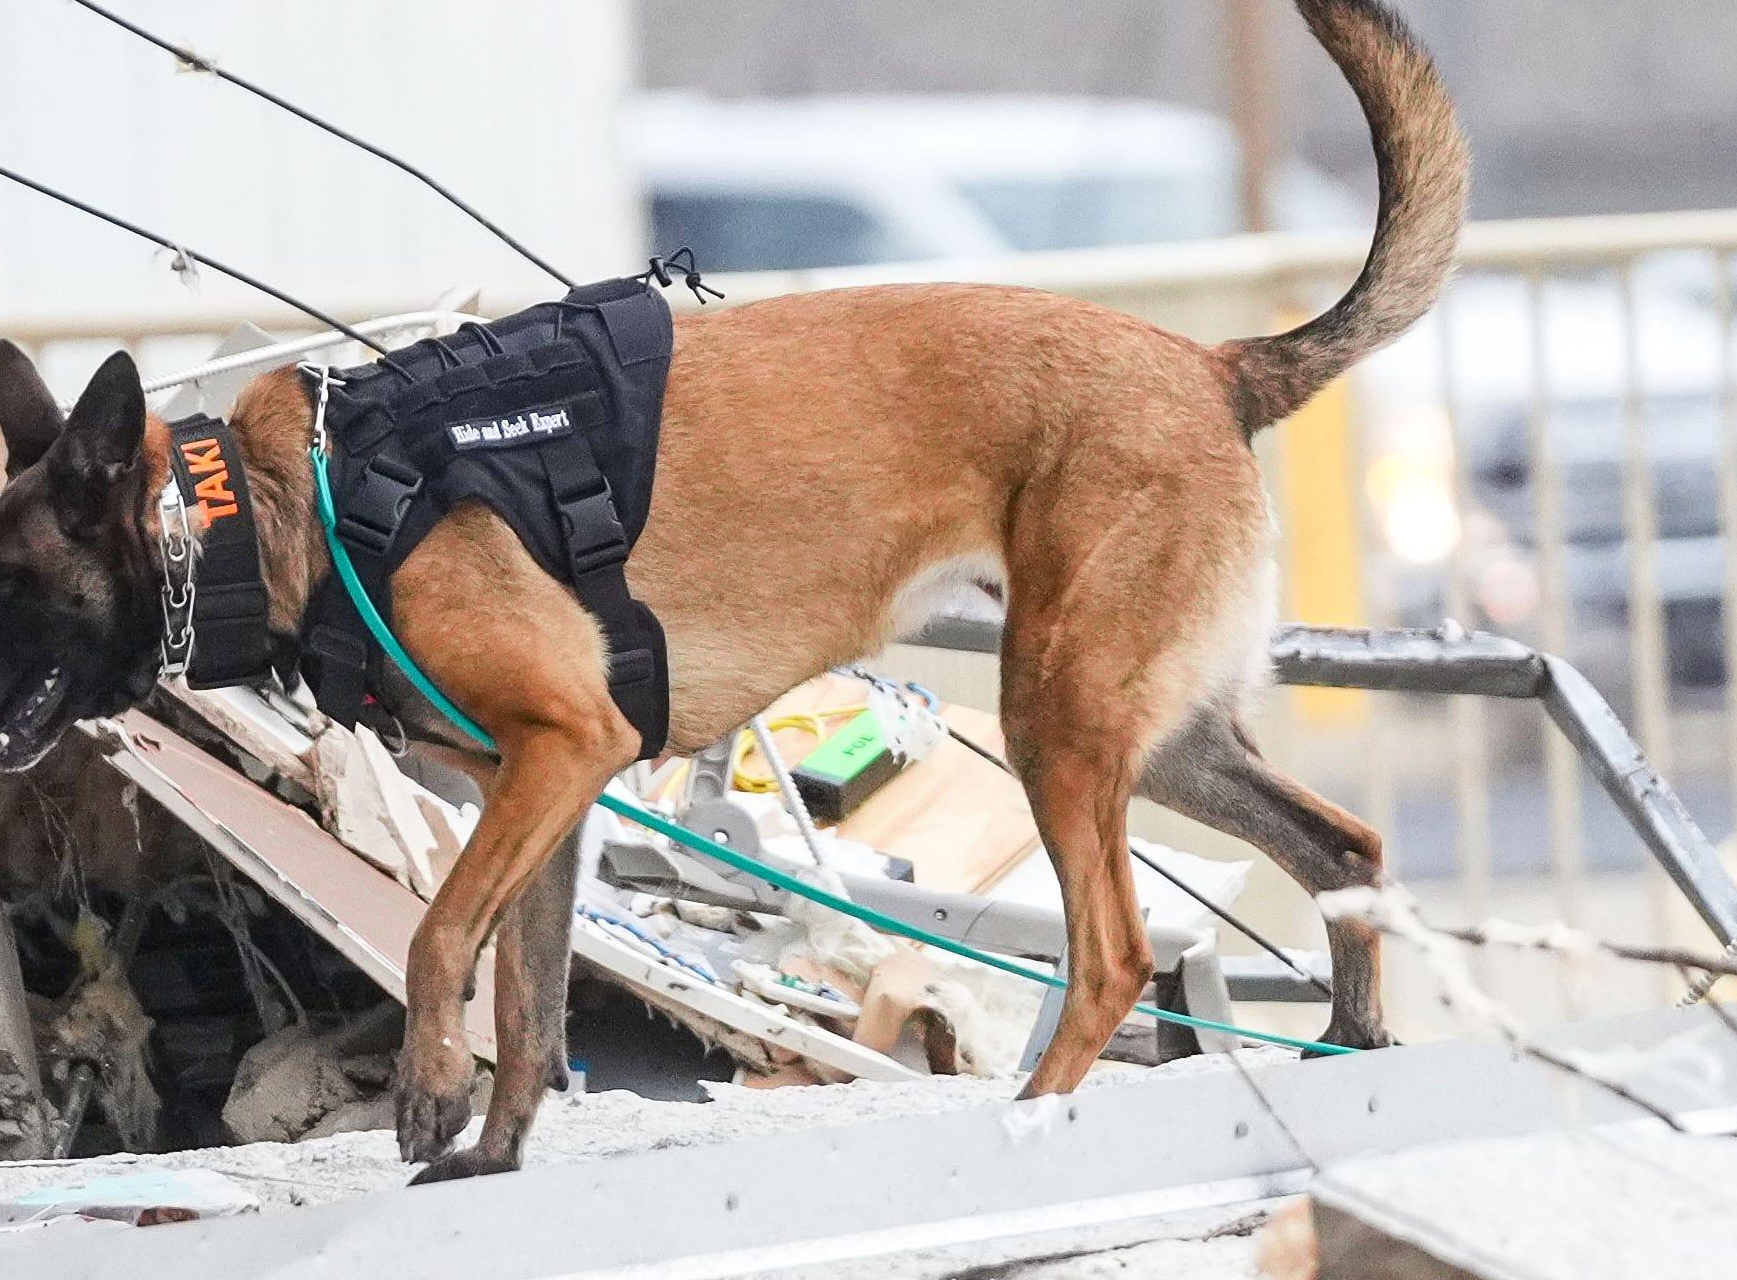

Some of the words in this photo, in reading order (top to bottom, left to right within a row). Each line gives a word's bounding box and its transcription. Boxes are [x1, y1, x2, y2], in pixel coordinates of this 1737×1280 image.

[451, 423, 481, 443] Hide
[481, 421, 503, 440] and
[501, 415, 531, 439] Seek
[529, 409, 570, 434] Expert
[180, 438, 239, 530] TAKI
